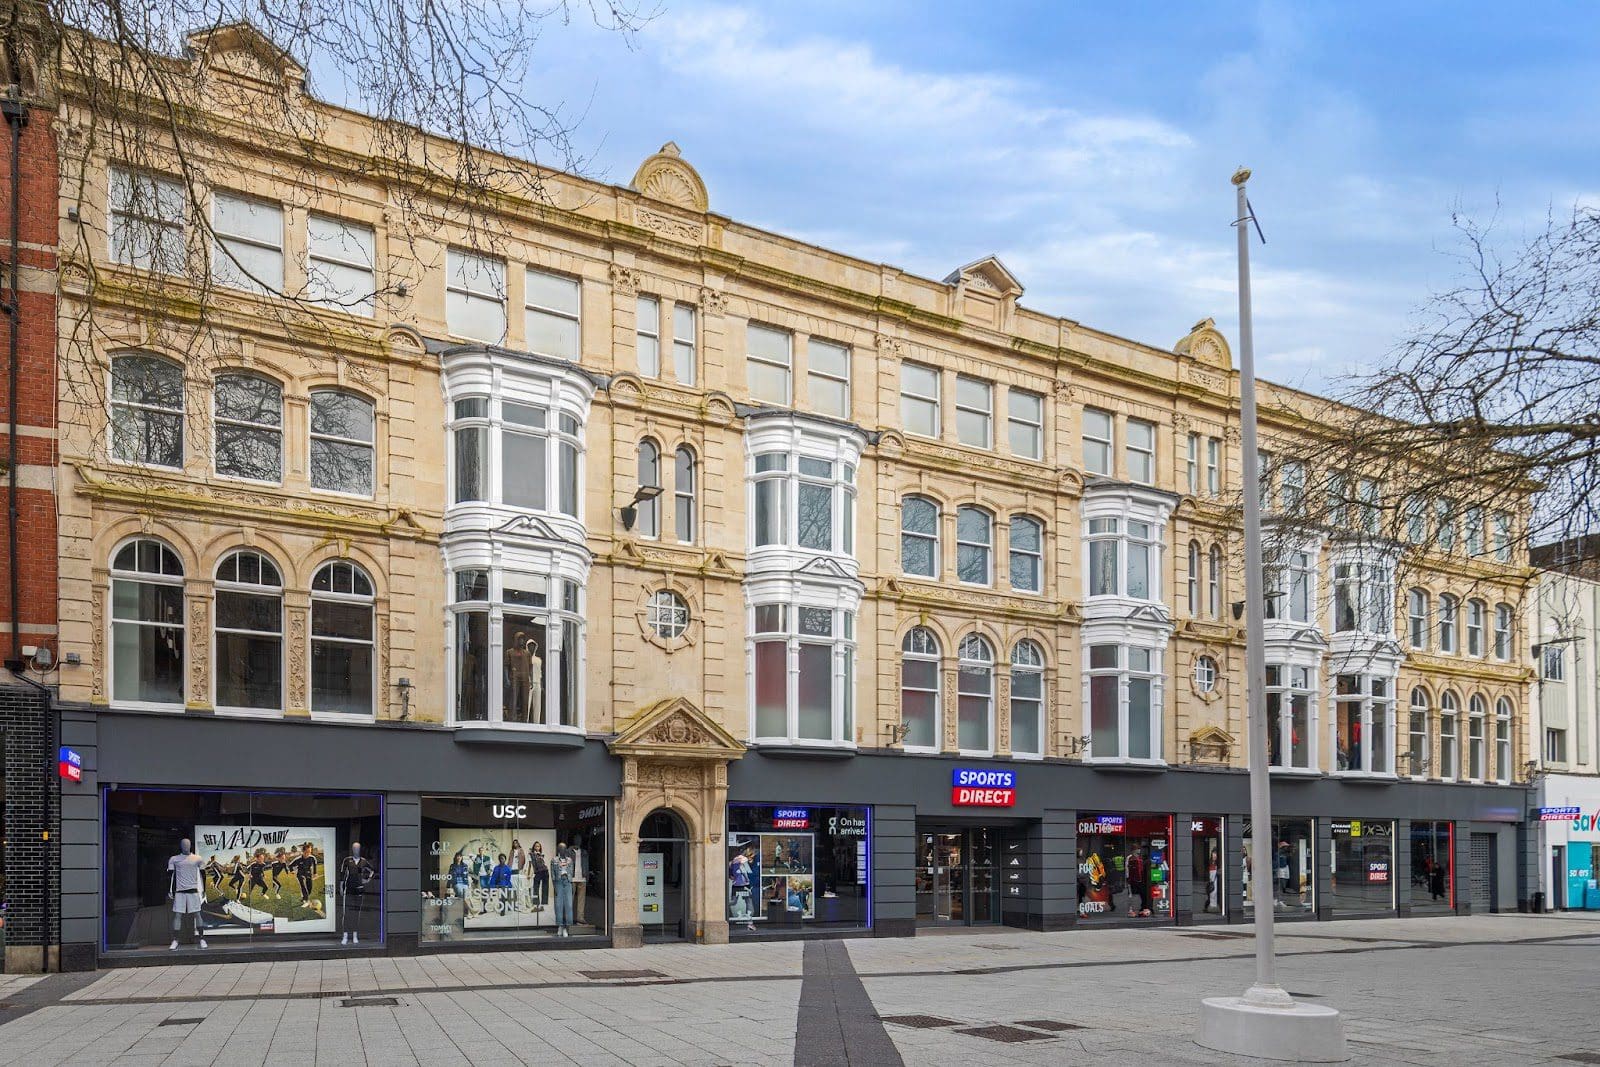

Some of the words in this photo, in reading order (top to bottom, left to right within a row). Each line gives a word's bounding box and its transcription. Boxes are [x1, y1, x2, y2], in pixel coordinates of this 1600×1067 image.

[959, 771, 1013, 786] SPORTS
[959, 789, 1012, 804] DIRECT
[492, 805, 527, 819] USC
[777, 810, 807, 818] SPORTS
[777, 820, 806, 828] DIRECT
[840, 817, 852, 826] On
[853, 817, 866, 827] has
[840, 827, 867, 836] arrived.
[214, 827, 262, 851] MAD
[262, 828, 290, 845] READY
[429, 873, 453, 881] HUGO
